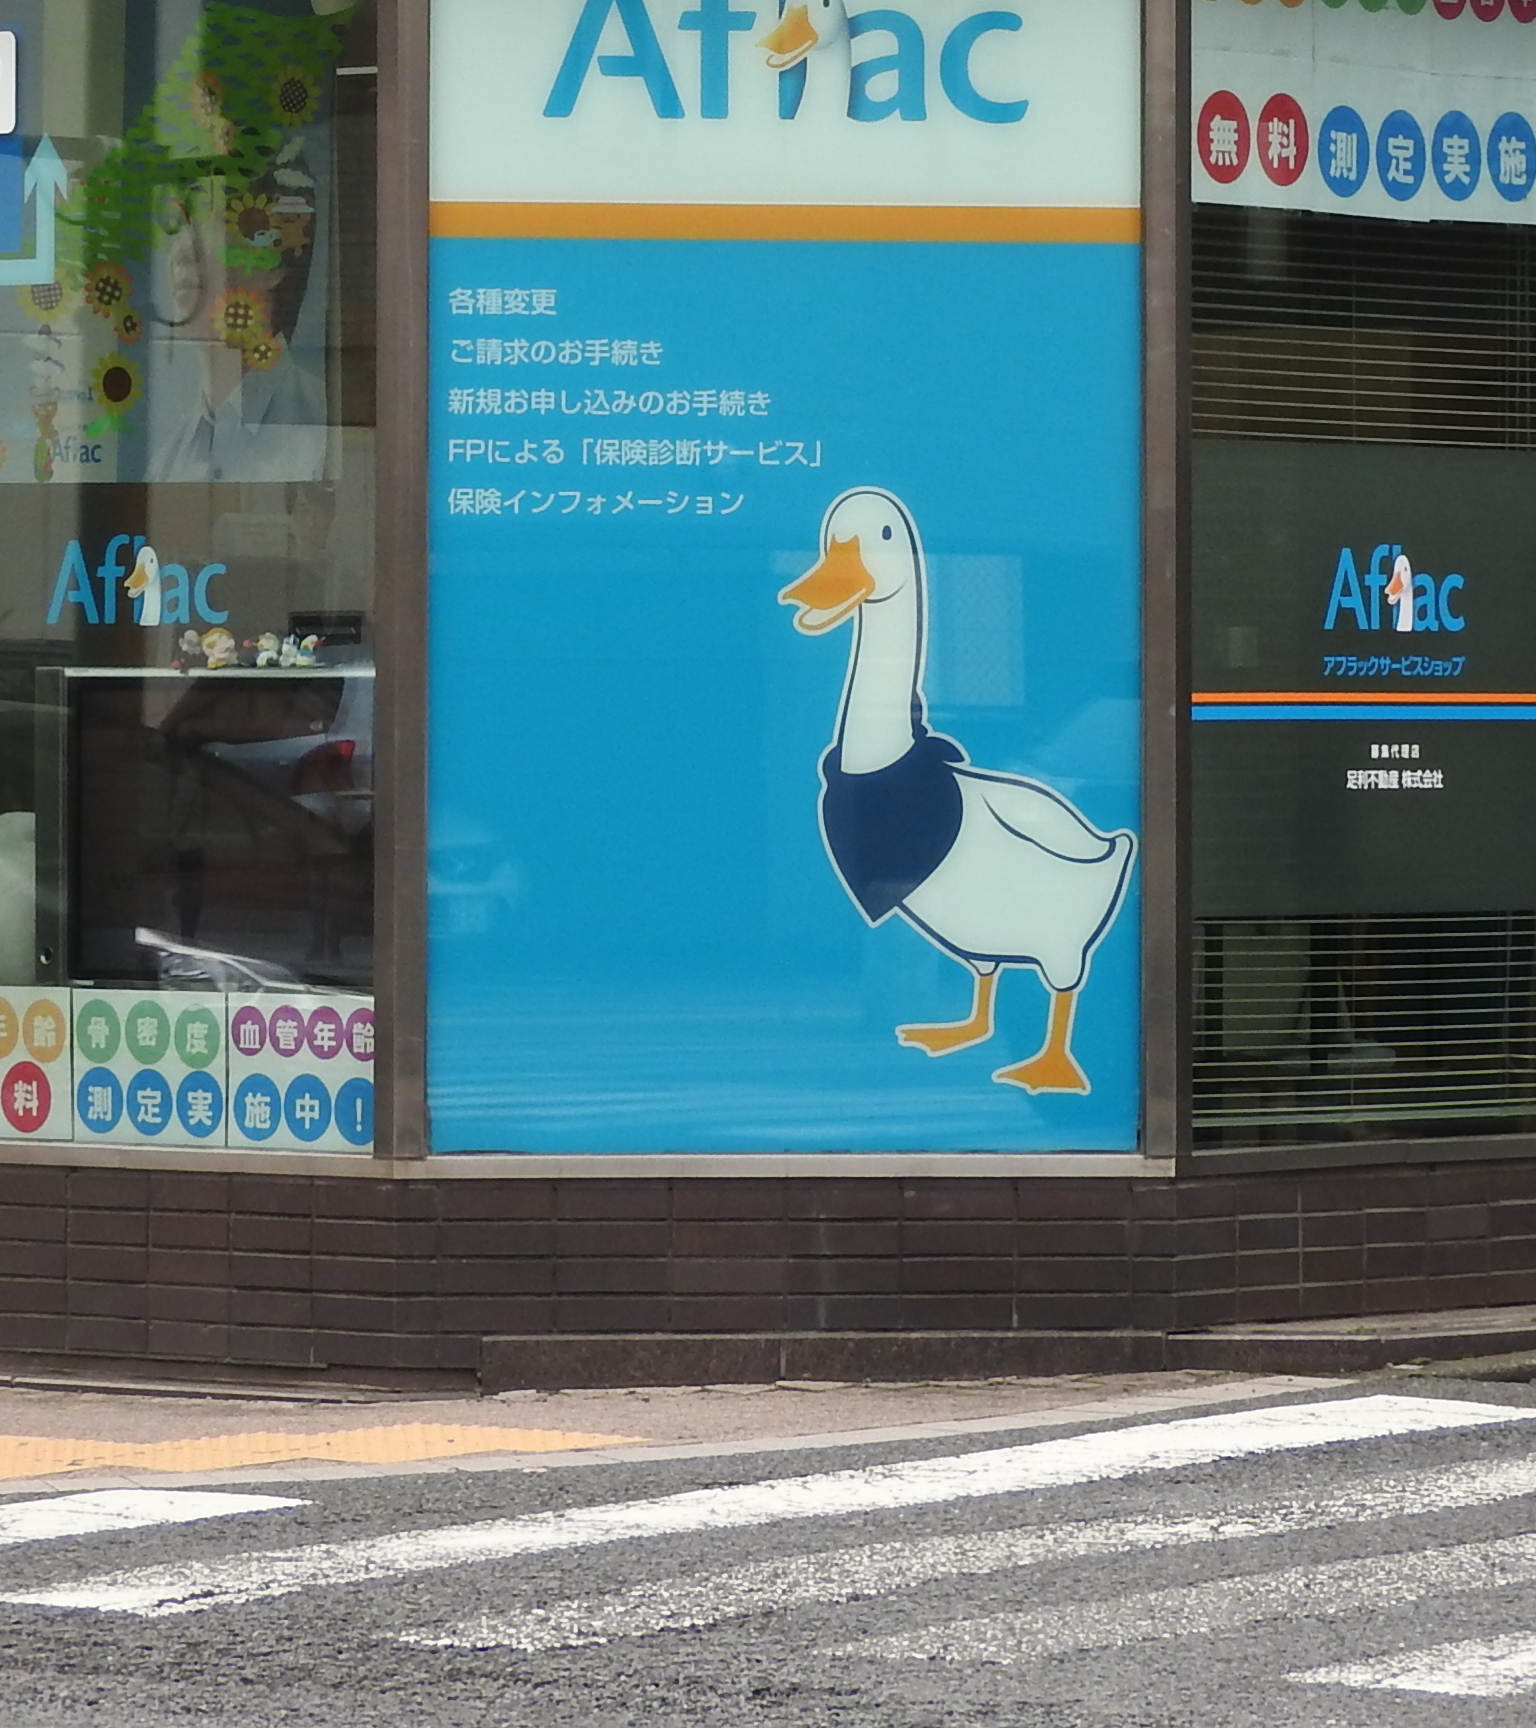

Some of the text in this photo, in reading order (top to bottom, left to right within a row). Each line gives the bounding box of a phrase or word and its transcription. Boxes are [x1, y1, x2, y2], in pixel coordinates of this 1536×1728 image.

[1207, 112, 1298, 171] 無料
[448, 287, 558, 316] 各種変更
[450, 338, 664, 367] ご請求のお手続き
[448, 388, 773, 417] 新規お申し込みのお手続き
[448, 438, 824, 468] FPによる「保険診断サービス」
[448, 488, 744, 516] 保険インフォメーション
[1322, 655, 1466, 677] アフラックサービスショップ
